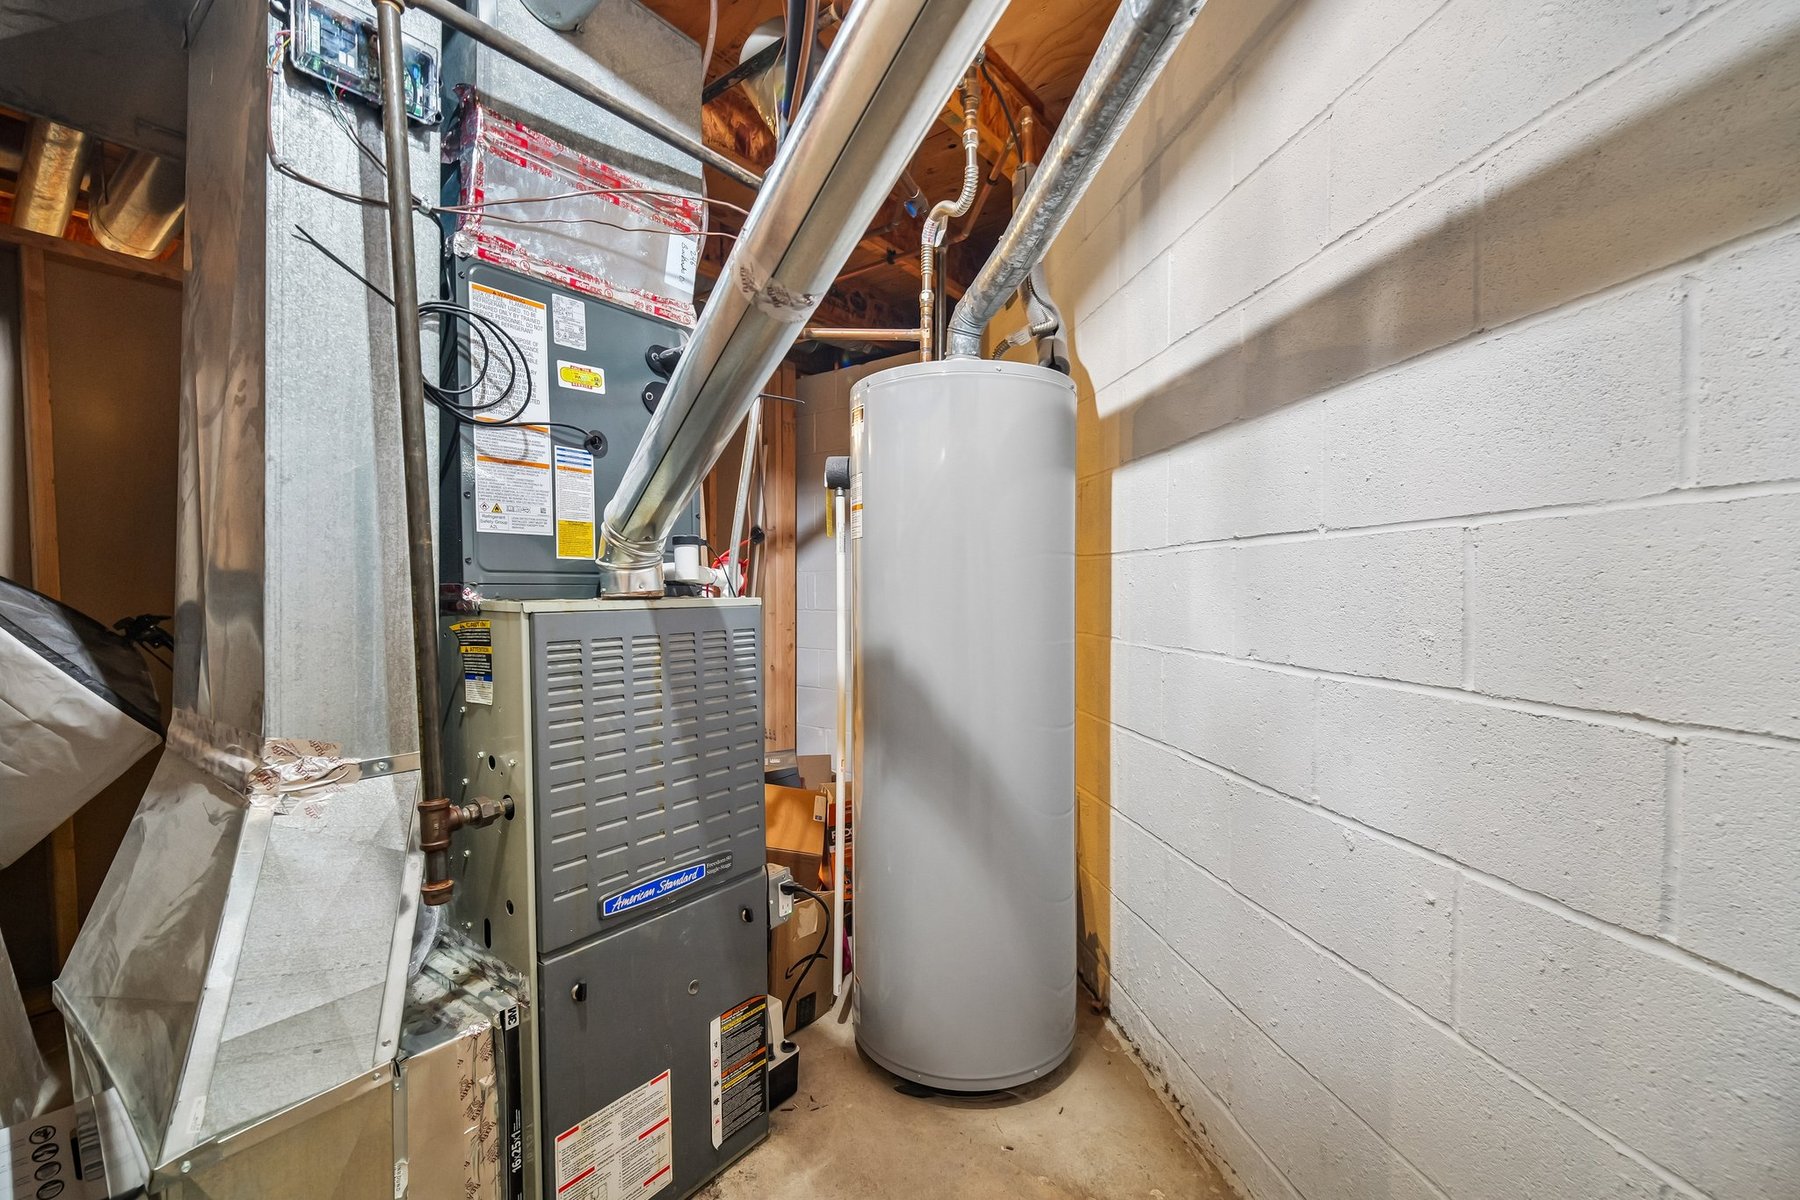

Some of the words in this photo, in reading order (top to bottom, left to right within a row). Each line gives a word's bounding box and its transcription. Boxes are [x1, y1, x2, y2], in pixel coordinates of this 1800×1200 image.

[612, 887, 655, 912] American
[657, 867, 700, 894] Standard
[507, 1006, 518, 1026] 3M
[511, 1130, 522, 1173] 16x25x1
